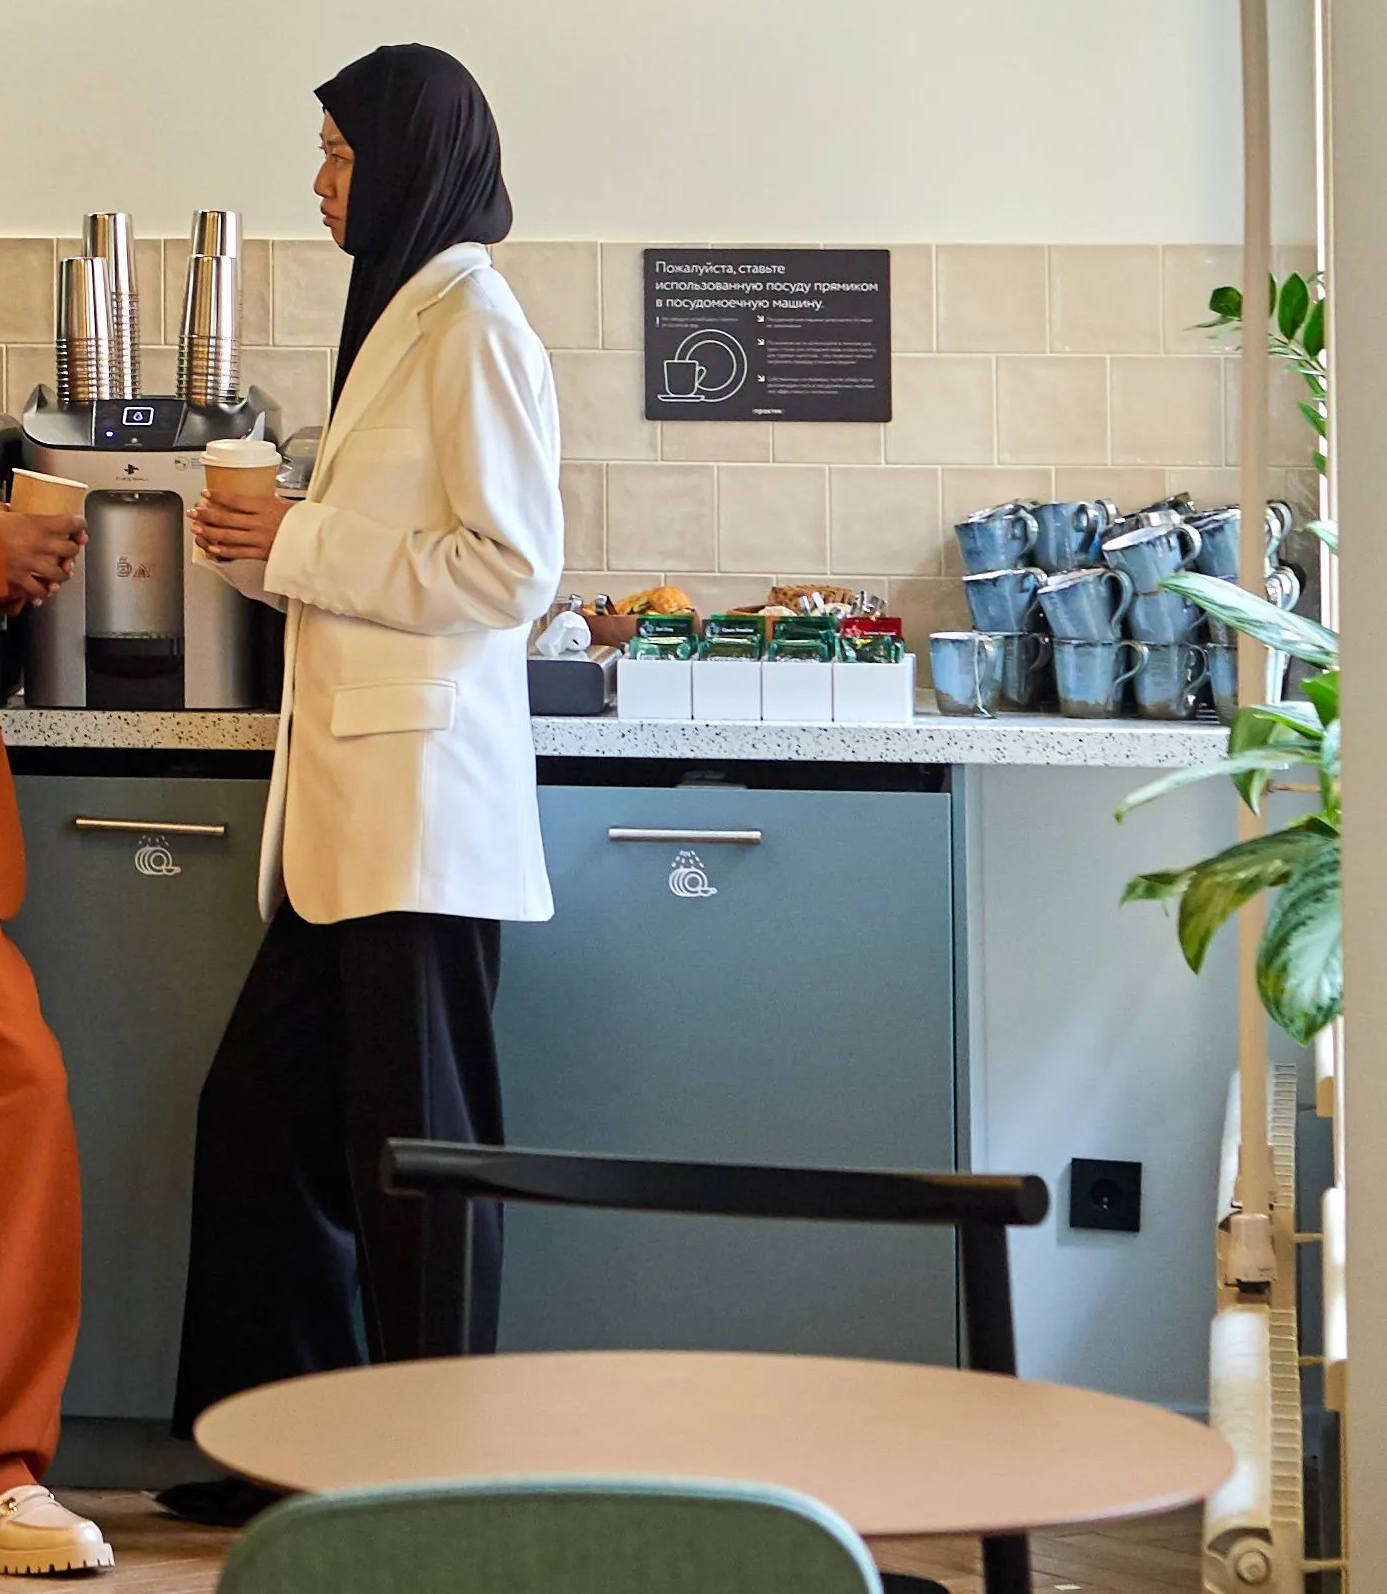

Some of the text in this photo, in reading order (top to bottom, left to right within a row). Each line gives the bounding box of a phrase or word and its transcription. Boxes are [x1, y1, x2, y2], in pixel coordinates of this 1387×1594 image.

[655, 260, 786, 276] Пожалуйста, ставьте
[655, 281, 879, 295] использованную посуду прямиком
[655, 298, 825, 312] в посудомоечную машину.
